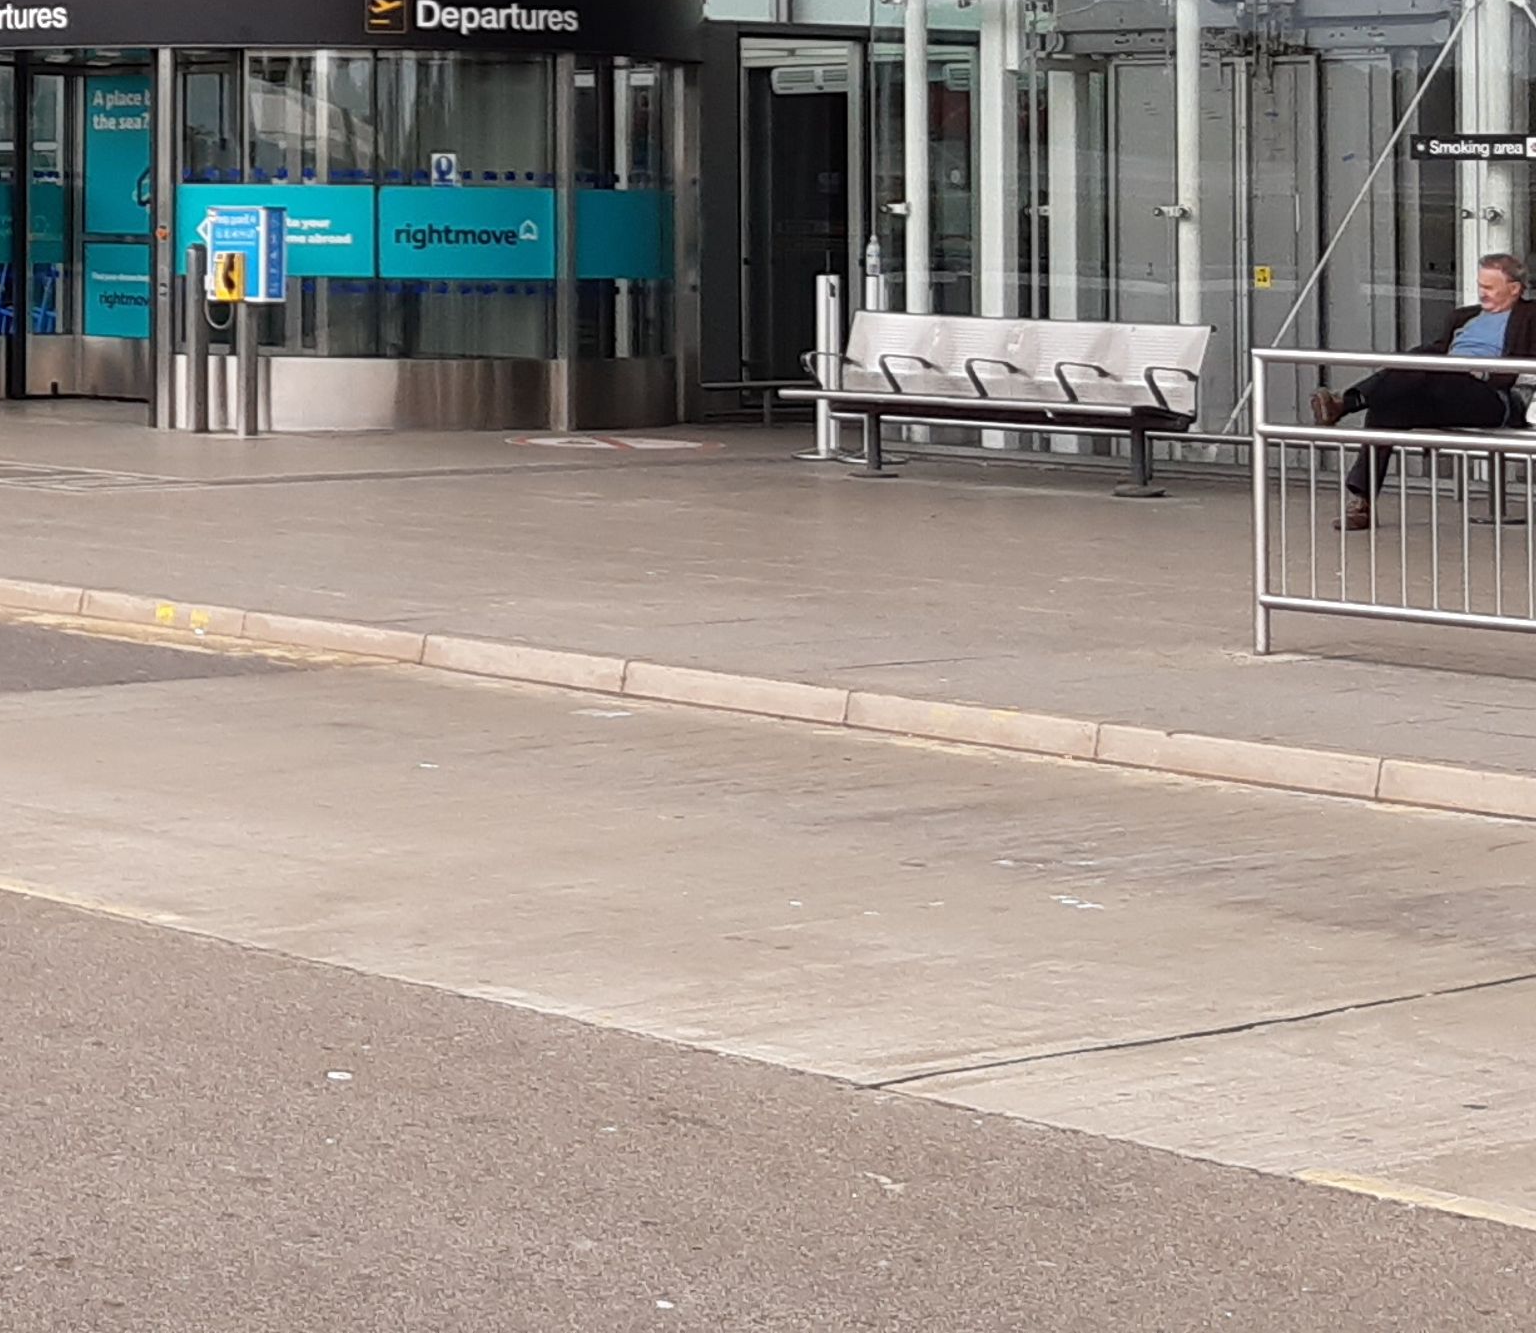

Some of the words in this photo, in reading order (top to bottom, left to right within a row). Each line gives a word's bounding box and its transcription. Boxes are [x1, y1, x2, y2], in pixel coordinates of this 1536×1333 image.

[416, 0, 579, 35] Departures
[92, 89, 104, 106] A
[106, 90, 142, 111] place
[92, 114, 117, 131] the
[1429, 139, 1490, 157] Smoking
[1493, 143, 1524, 155] area
[394, 223, 518, 250] rightmove
